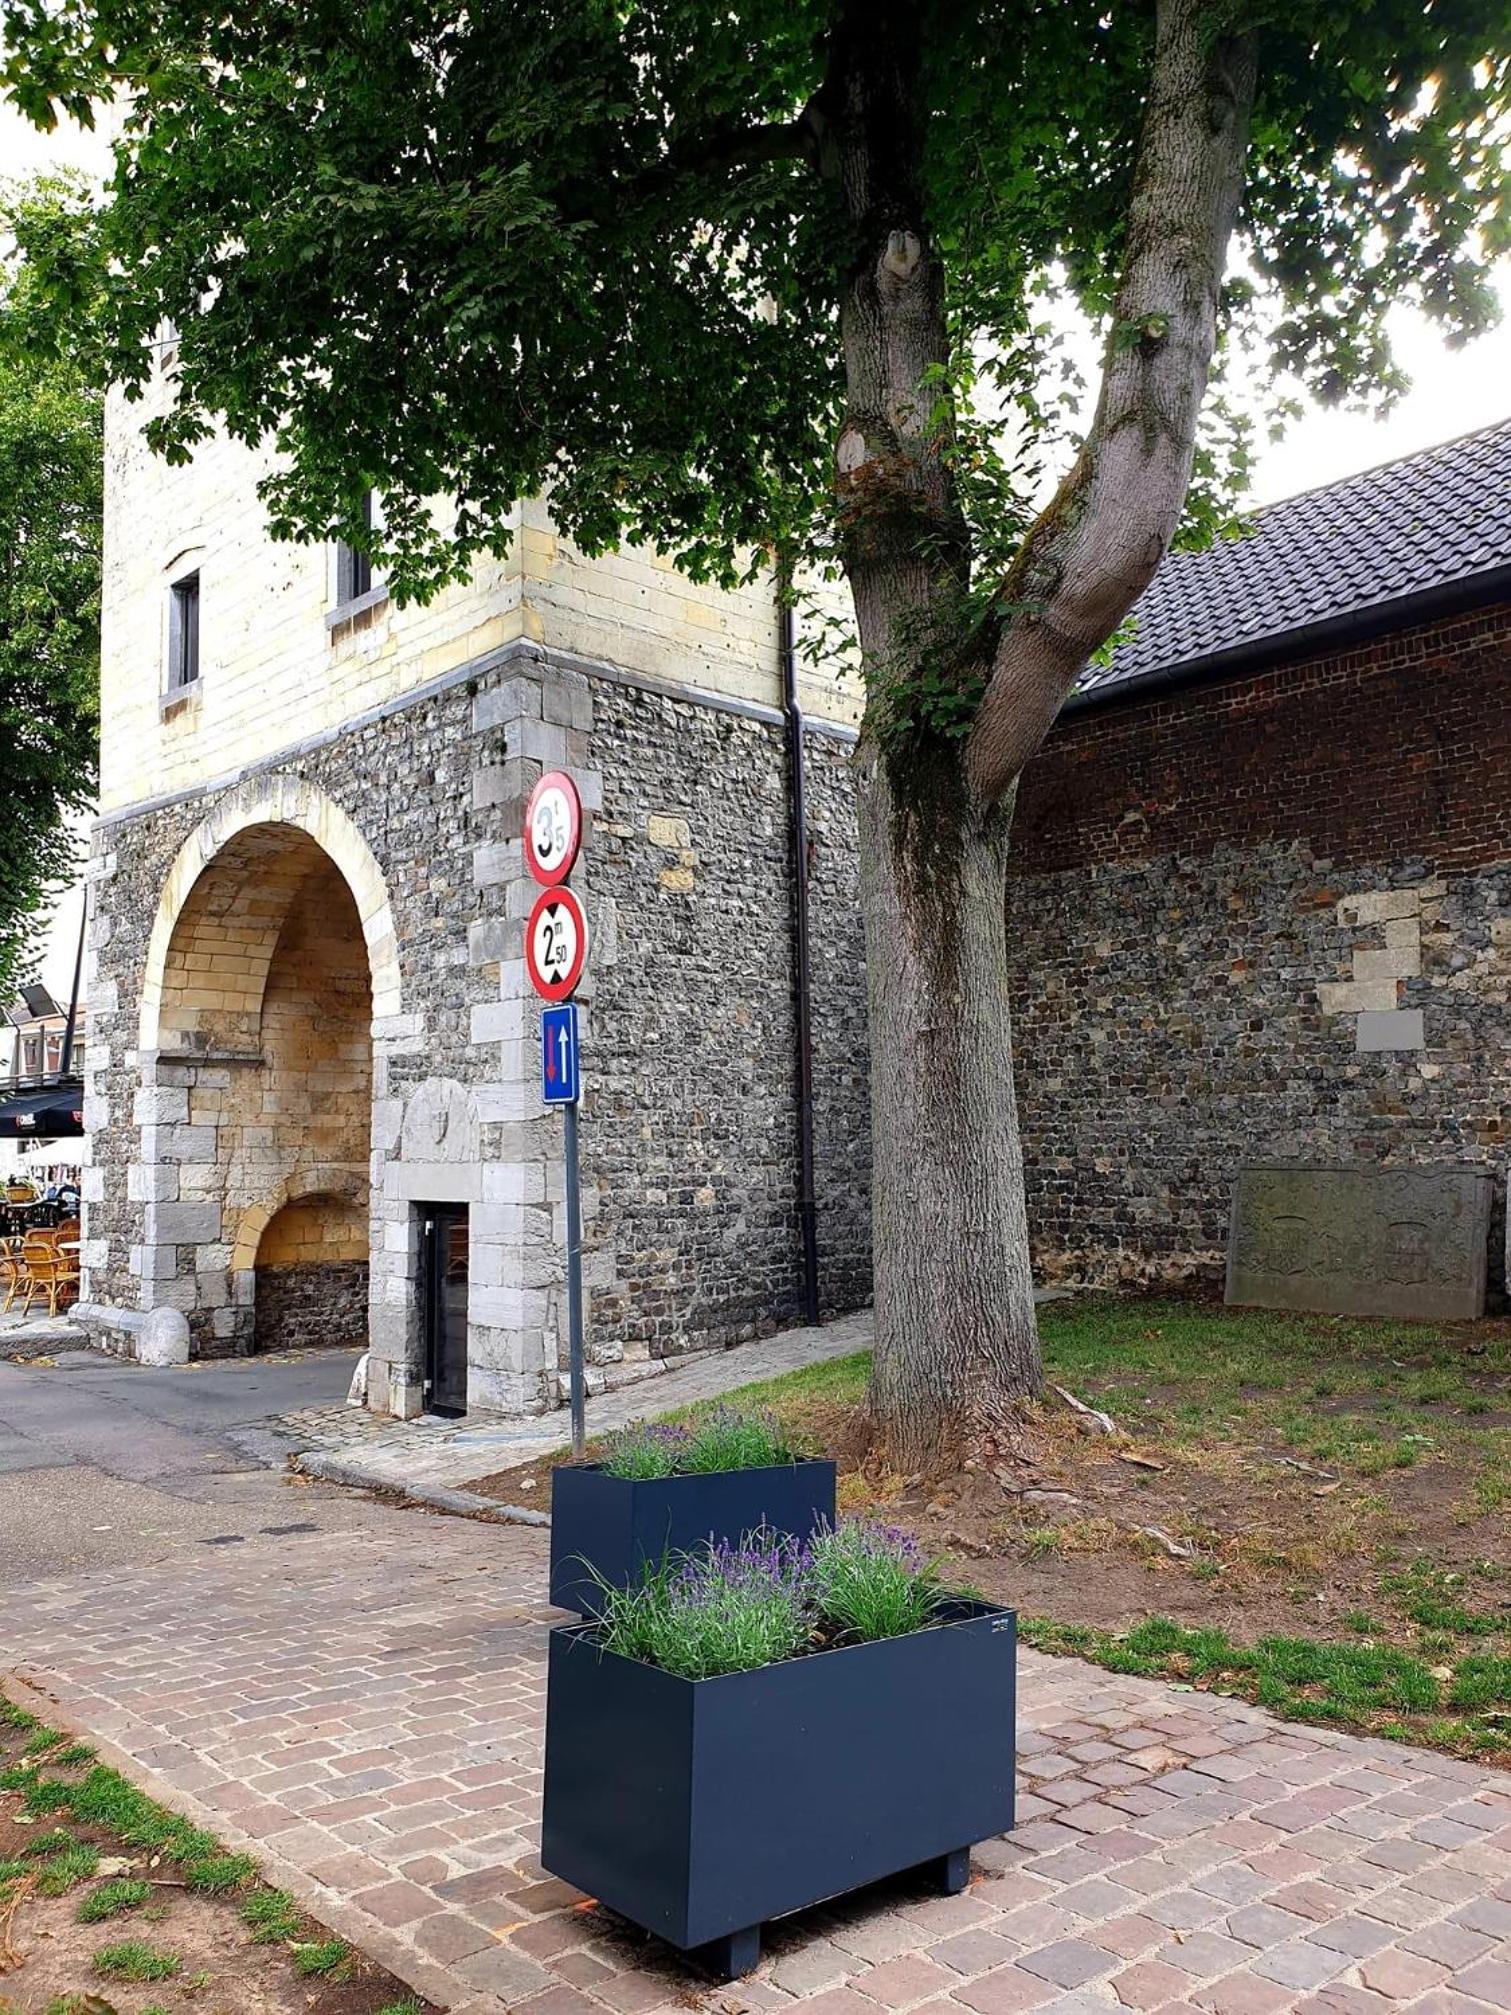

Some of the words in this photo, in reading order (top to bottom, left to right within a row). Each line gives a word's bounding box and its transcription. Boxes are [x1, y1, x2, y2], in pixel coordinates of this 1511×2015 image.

[537, 806, 553, 858] 3
[555, 825, 565, 853] 5
[543, 925, 555, 966] 2
[556, 944, 567, 964] 50
[554, 921, 563, 935] m
